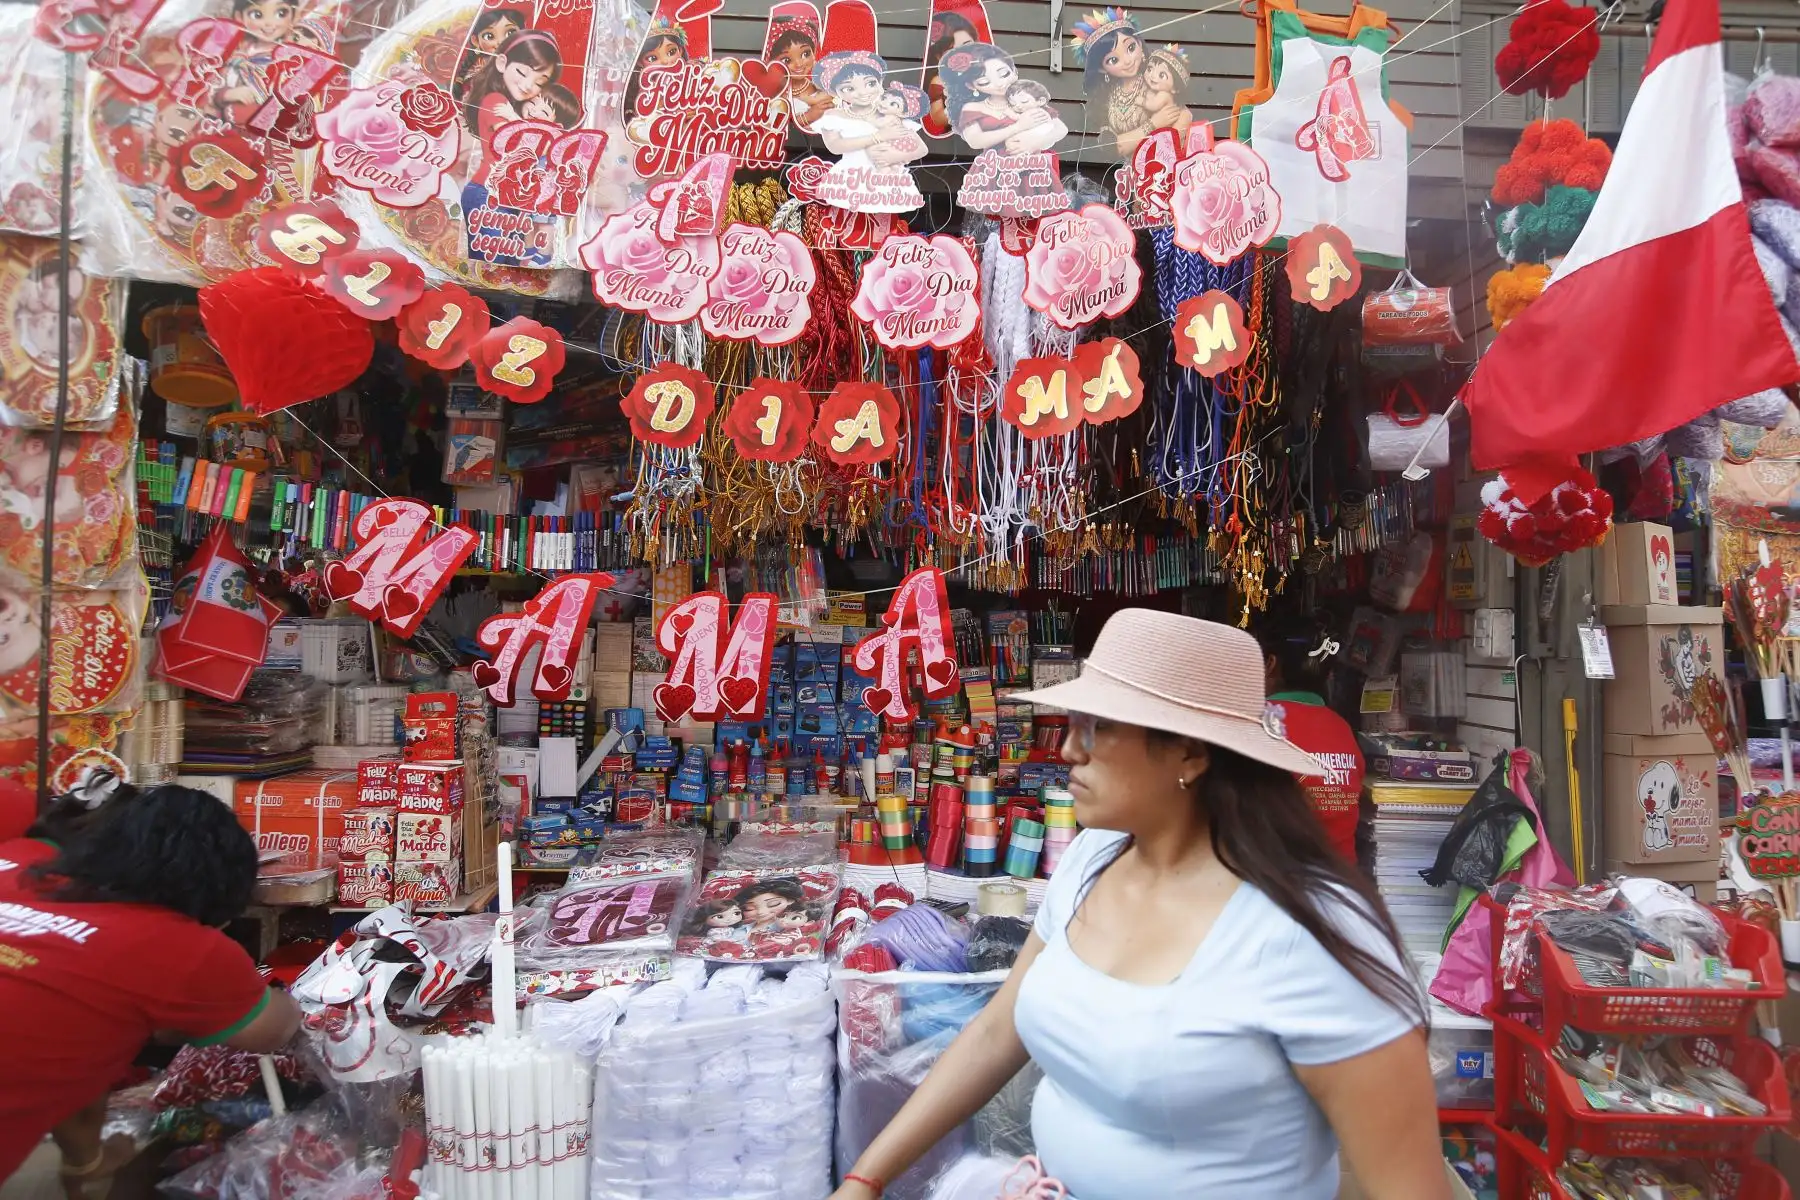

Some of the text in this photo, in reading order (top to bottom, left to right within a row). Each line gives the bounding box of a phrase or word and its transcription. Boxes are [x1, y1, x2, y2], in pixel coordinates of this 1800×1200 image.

[636, 58, 716, 117] Feliz
[717, 83, 770, 129] Día
[400, 134, 446, 168] Día
[634, 111, 787, 178] Mamá
[334, 144, 418, 195] Mamá
[974, 149, 1048, 178] Gracias
[1178, 155, 1227, 191] Feliz
[962, 170, 1052, 190] por ser mi
[1230, 168, 1265, 202] Día
[848, 192, 925, 213] guerrera
[957, 188, 1071, 218] refugio seguro
[468, 207, 533, 238] ejemplo
[1041, 217, 1090, 251] Feliz
[1207, 203, 1270, 255] Mamá
[471, 233, 526, 262] seguir
[723, 231, 779, 263] Feliz
[883, 241, 938, 269] Feliz
[1087, 241, 1131, 271] Día
[664, 248, 713, 278] Día
[605, 270, 690, 310] Mamá
[762, 268, 809, 294] Día
[926, 273, 974, 298] Día
[1058, 273, 1128, 321] Mamá
[710, 301, 794, 332] Mamá
[883, 309, 962, 340] Mamá
[839, 602, 862, 610] Power
[94, 608, 116, 655] Feliz
[1687, 776, 1700, 794] La
[1680, 798, 1704, 814] mejor
[1699, 812, 1712, 827] del
[344, 819, 366, 829] FELIZ
[341, 830, 390, 854] Madre
[400, 836, 447, 852] Madre
[344, 867, 366, 877] FELIZ
[394, 869, 423, 882] Feliz
[341, 878, 390, 901] Madre
